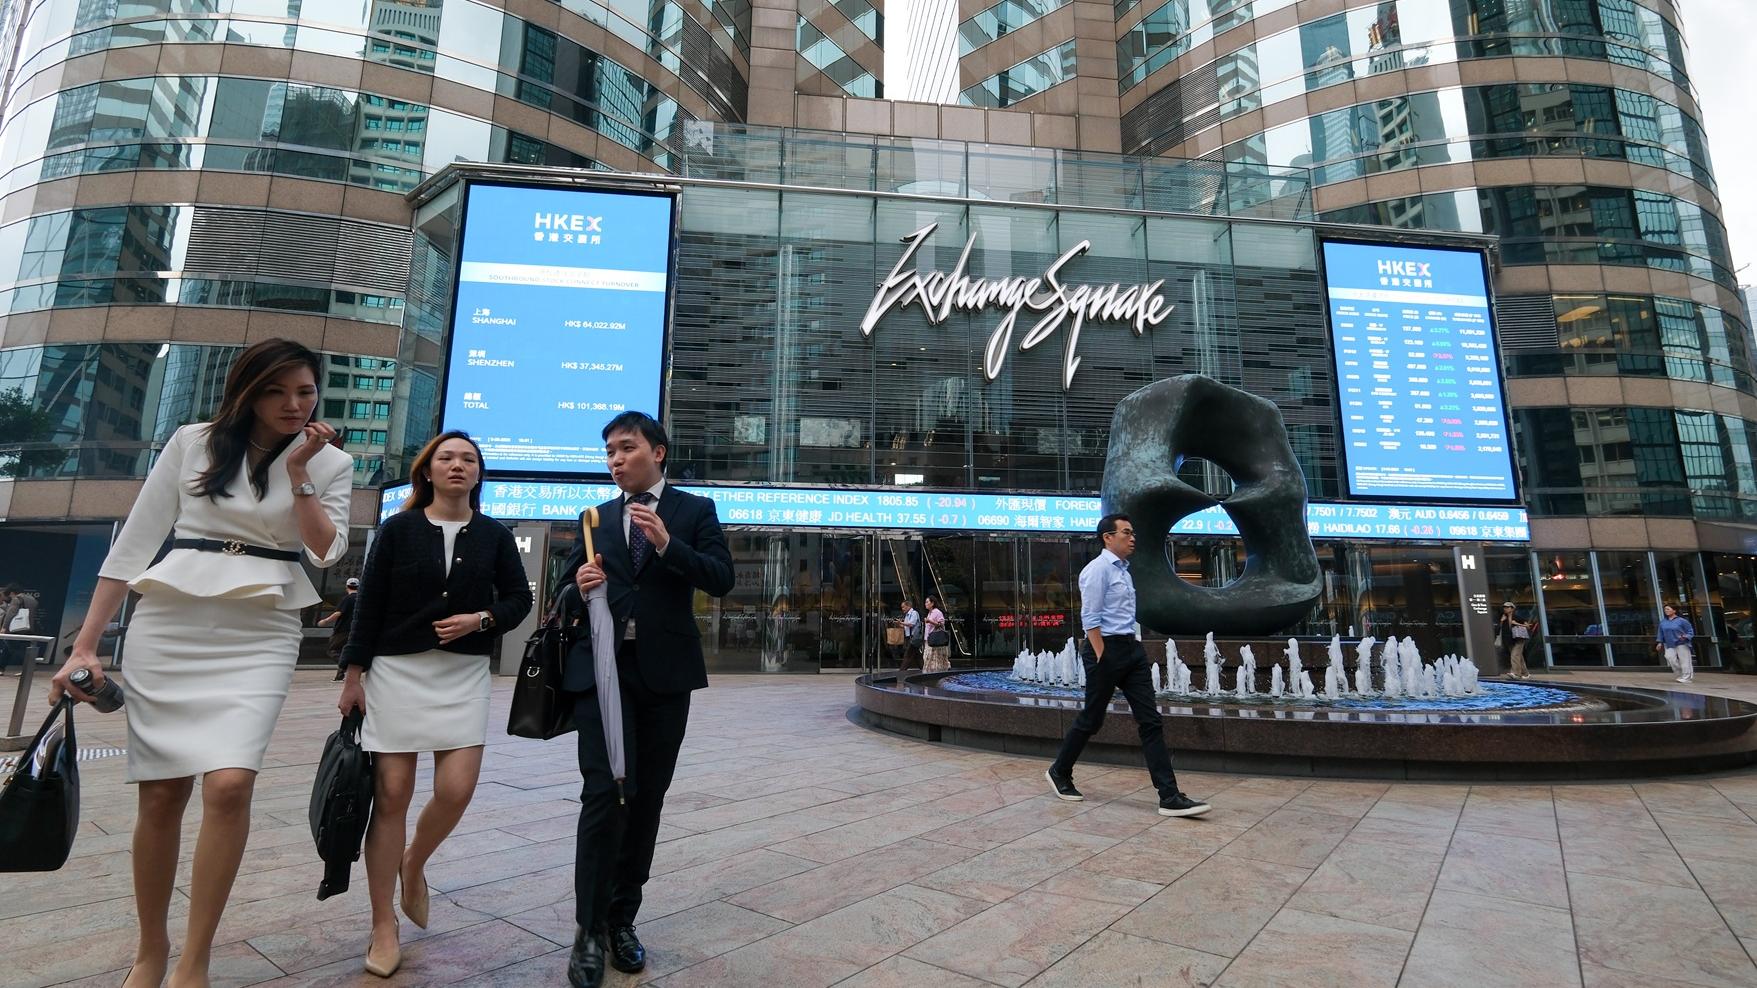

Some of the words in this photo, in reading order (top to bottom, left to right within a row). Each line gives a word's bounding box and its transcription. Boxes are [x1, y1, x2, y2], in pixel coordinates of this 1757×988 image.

[535, 213, 603, 231] HKEX
[1377, 259, 1432, 277] HKEX
[488, 273, 539, 283] SOUTHBOUND
[602, 280, 641, 288] TURNOVER
[860, 222, 1047, 383] Exchange
[1019, 239, 1175, 391] Square
[471, 316, 517, 326] SHANGHAI
[564, 320, 581, 328] HK$
[467, 358, 514, 367] SHENZHEN
[561, 361, 578, 370] HK$
[580, 362, 623, 372] 37,345.27M
[463, 401, 489, 409] TOTAL
[558, 401, 574, 409] HK$
[714, 491, 754, 502] ETHER
[757, 492, 830, 504] REFERENCE
[833, 494, 869, 505] INDEX
[878, 496, 919, 507] 1805.85
[480, 502, 537, 517] 中國銀行
[543, 504, 578, 516] BANK
[1415, 510, 1437, 520] AUD
[729, 509, 763, 520] 06618
[767, 509, 822, 523] 京東健康
[828, 511, 843, 522] JD
[846, 512, 893, 523] HEALTH
[897, 513, 927, 524] 37.55
[977, 514, 1010, 526] 06690
[1014, 514, 1065, 528] 海爾智家
[1323, 523, 1372, 534] HAIDILAO
[515, 536, 532, 553] H
[1461, 555, 1475, 569] H
